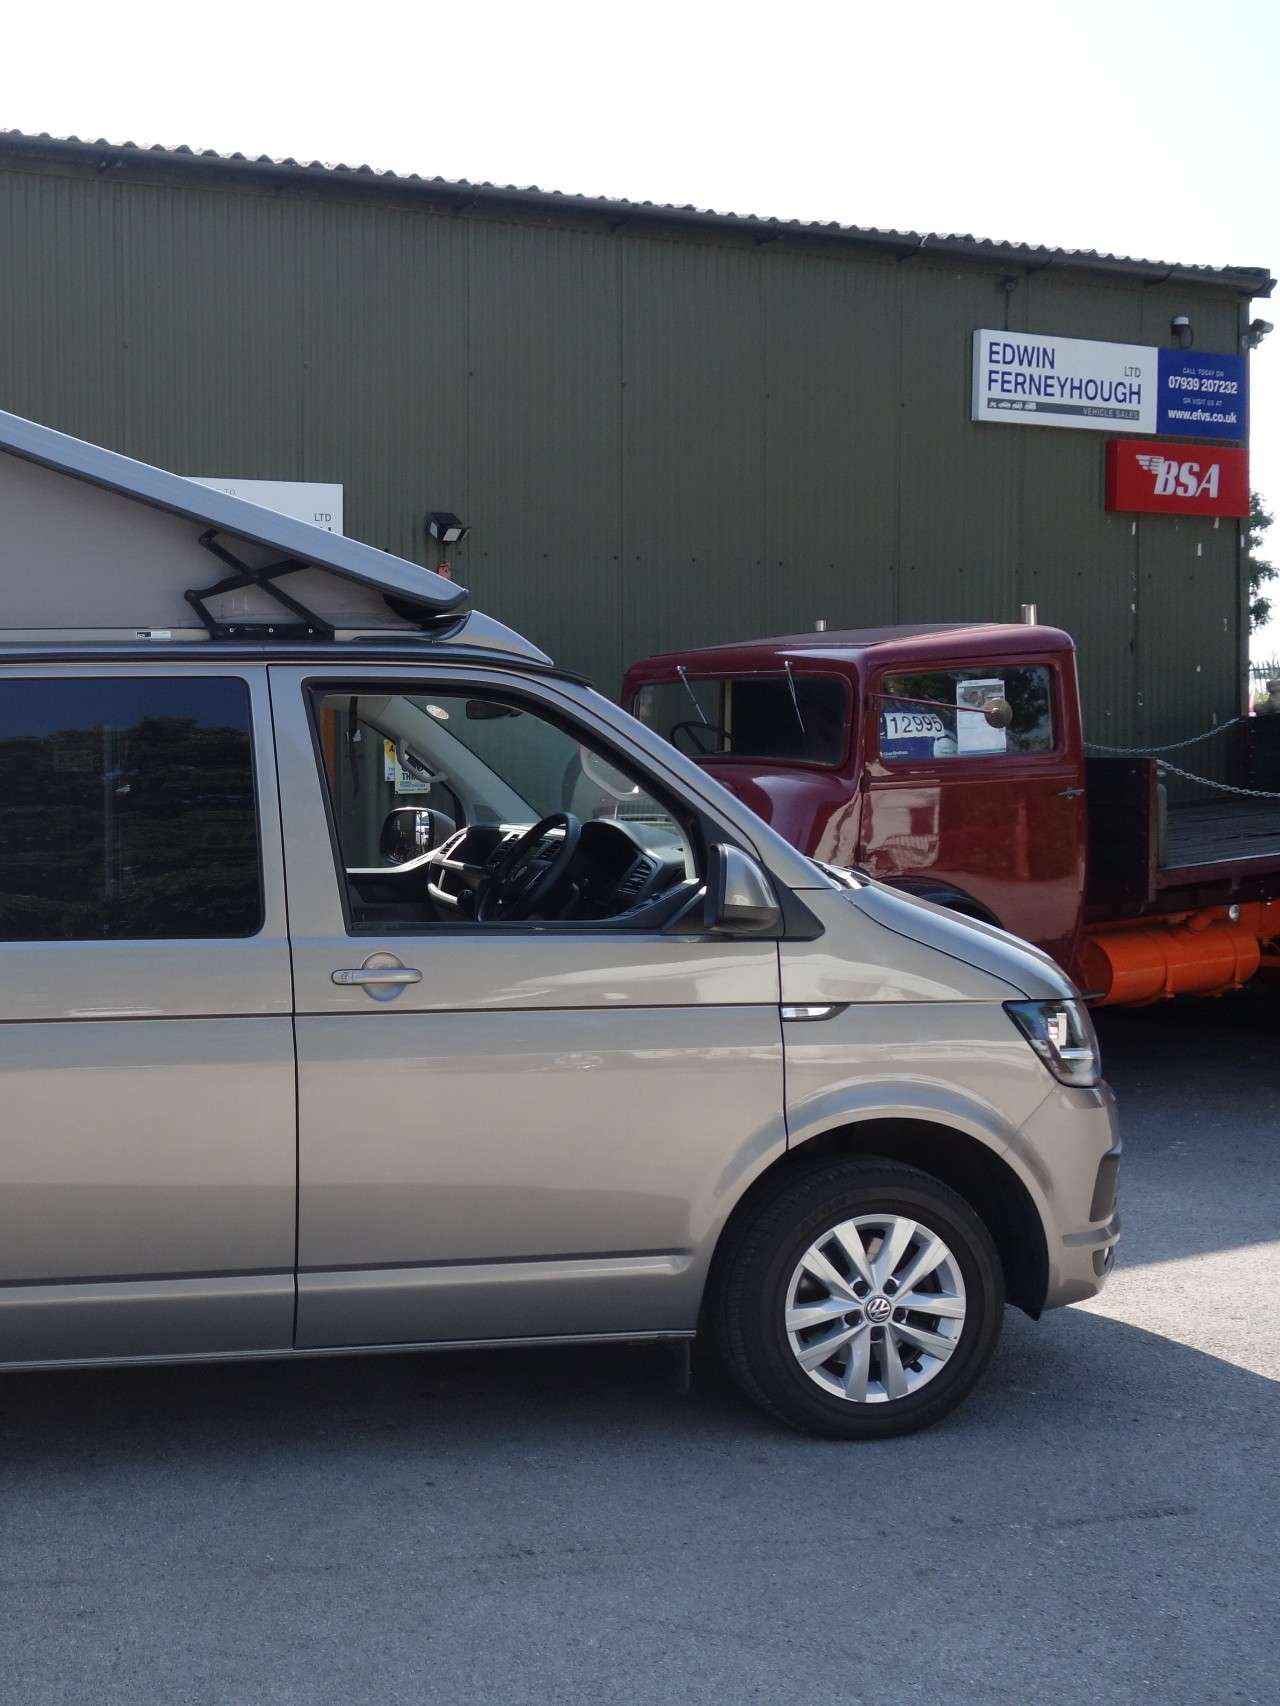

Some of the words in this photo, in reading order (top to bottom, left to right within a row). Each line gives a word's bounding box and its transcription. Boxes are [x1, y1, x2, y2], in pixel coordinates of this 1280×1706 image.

[988, 341, 1055, 369] EDWIN
[1124, 365, 1141, 378] LTD
[987, 369, 1141, 405] FERNEYHOUGH
[1168, 375, 1199, 390] 07939
[1201, 379, 1238, 394] 207232
[1083, 407, 1113, 419] VEHICLE
[1115, 410, 1140, 421] SALES
[1168, 408, 1237, 424] www.efvs.co.uk
[1153, 459, 1220, 498] BSA
[314, 513, 332, 522] LTD
[890, 714, 943, 734] 12995
